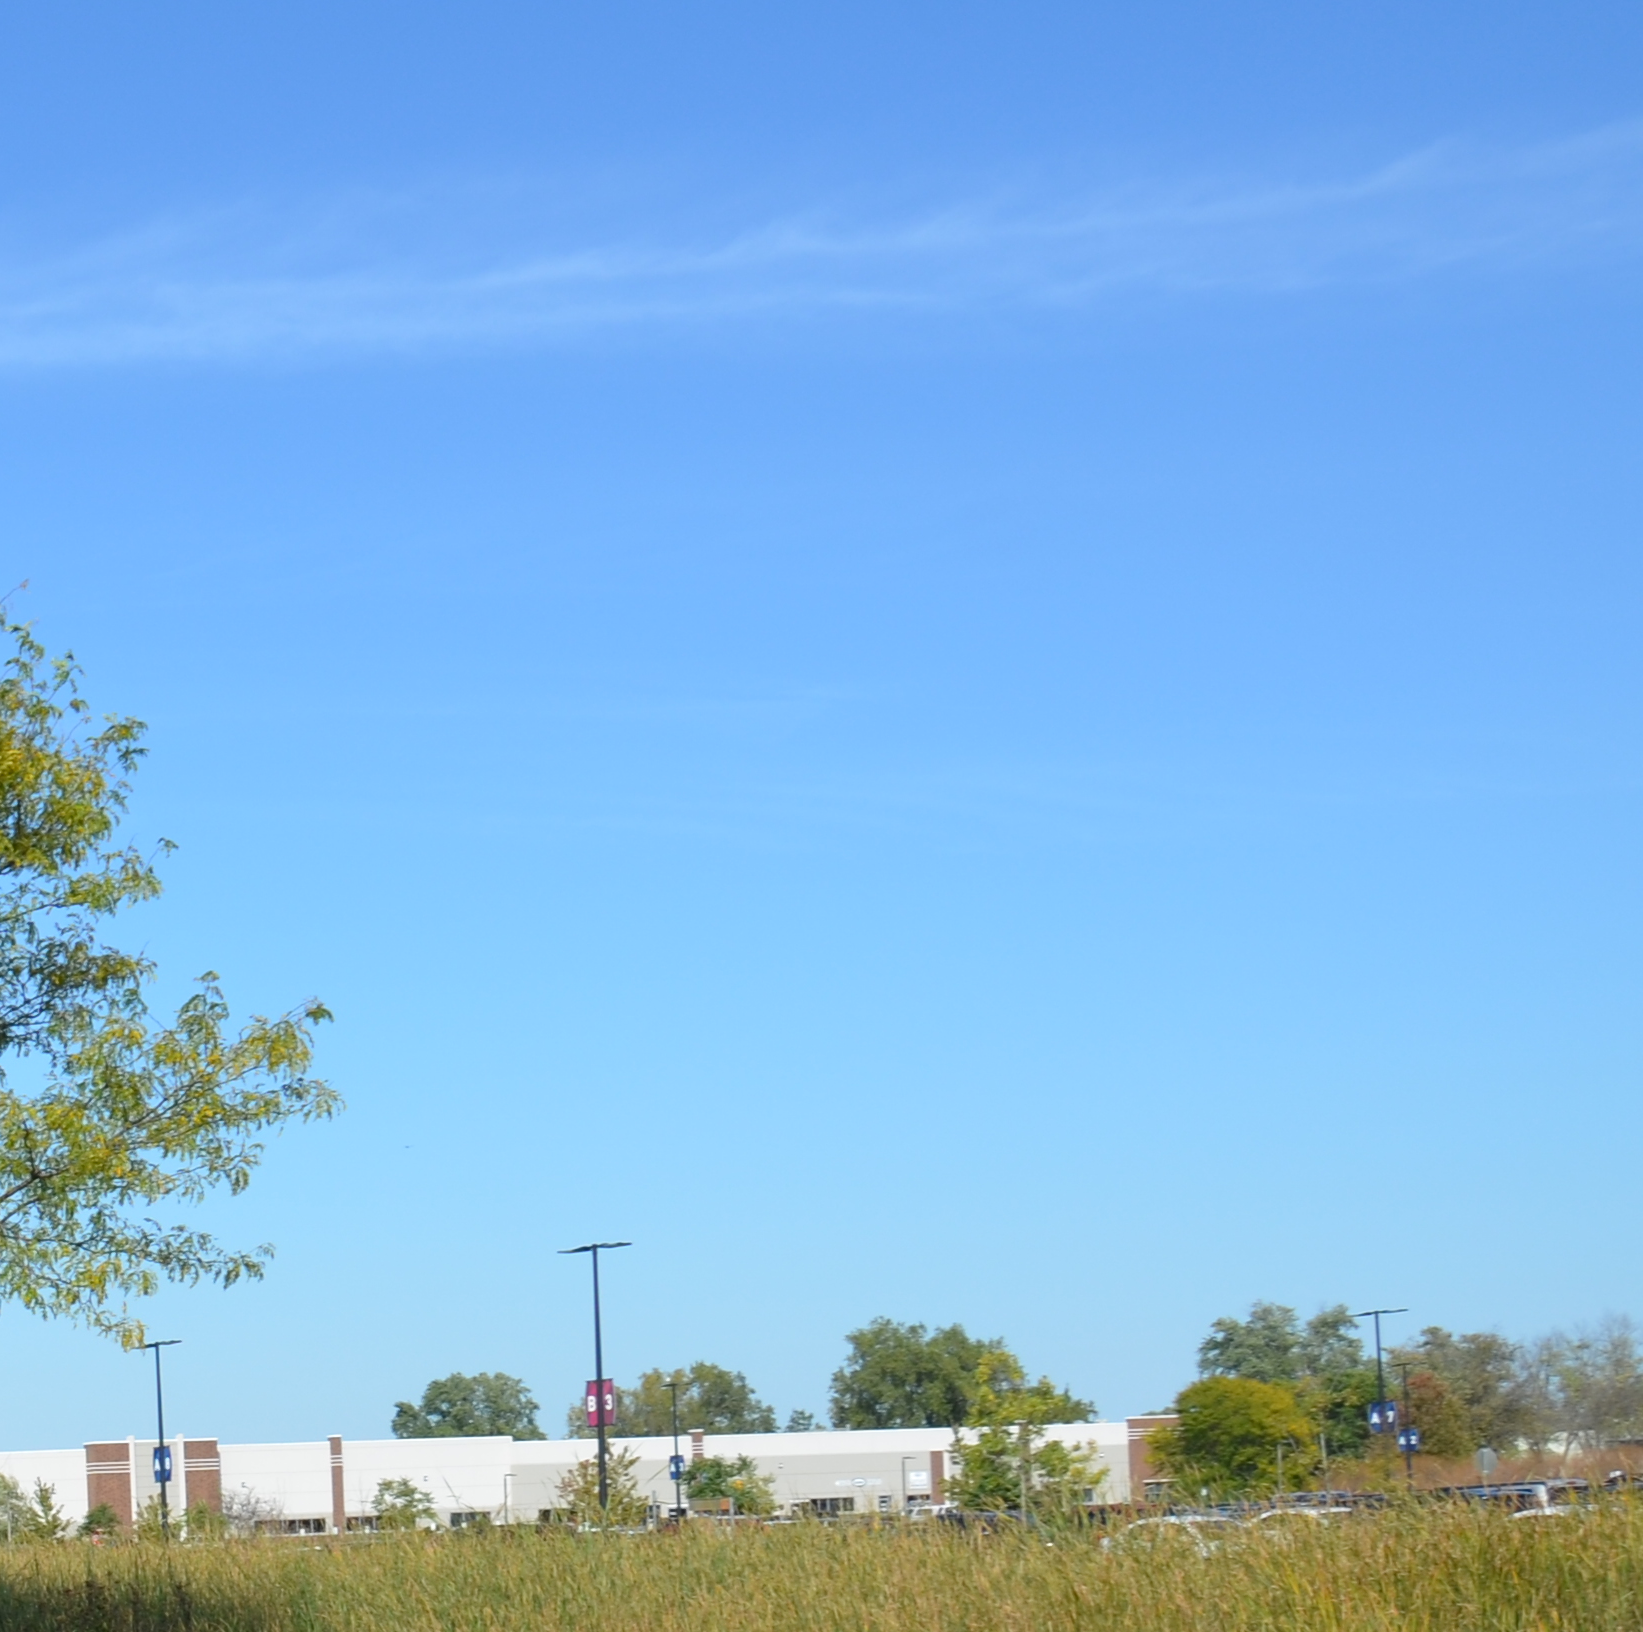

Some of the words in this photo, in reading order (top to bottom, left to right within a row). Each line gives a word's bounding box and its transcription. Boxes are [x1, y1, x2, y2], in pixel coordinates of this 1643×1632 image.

[587, 1395, 597, 1412] B
[604, 1393, 613, 1411] 3
[1370, 1412, 1381, 1424] A
[1386, 1410, 1395, 1423] 7
